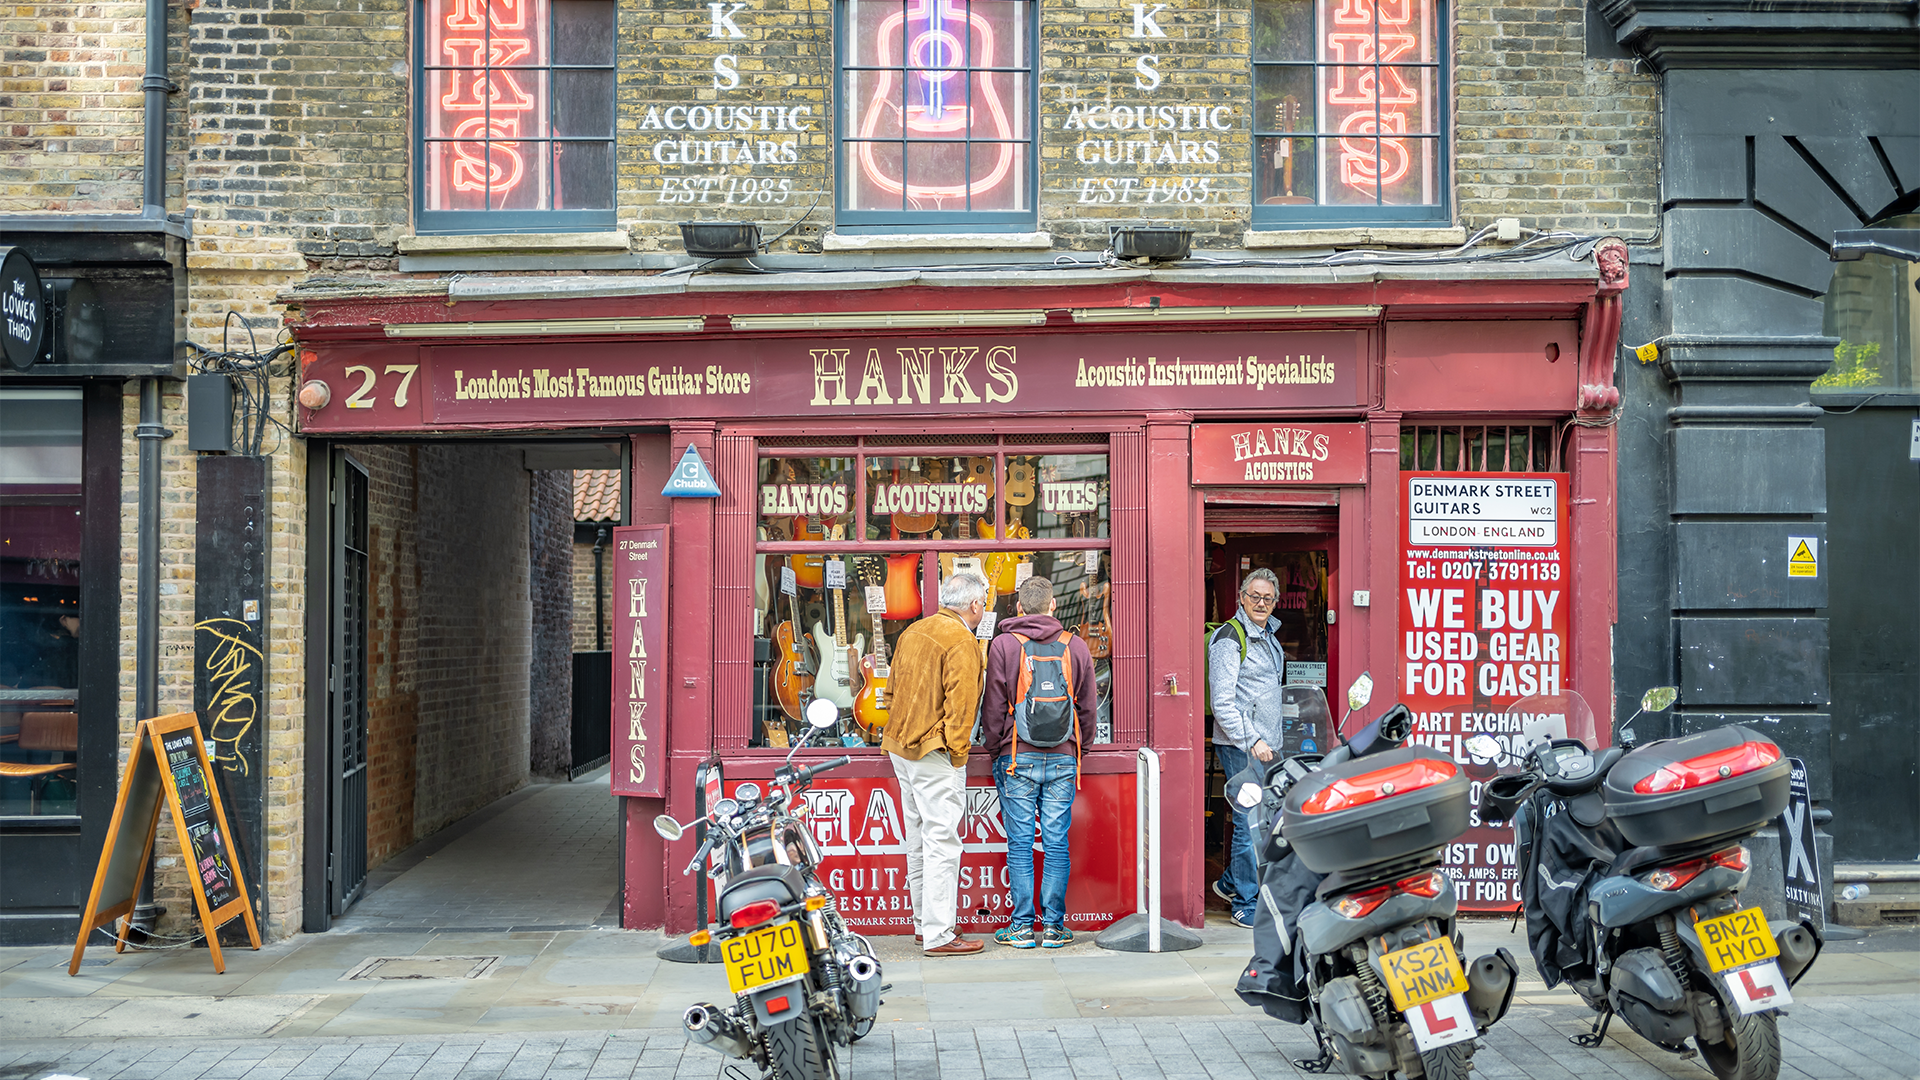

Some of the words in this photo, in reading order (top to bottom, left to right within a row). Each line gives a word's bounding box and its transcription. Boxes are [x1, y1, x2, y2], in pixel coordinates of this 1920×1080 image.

[640, 104, 812, 132] ACOUSTIC
[1063, 105, 1232, 131] ACOUSTIC
[653, 140, 798, 165] GUITARS
[1076, 140, 1220, 164] GUITARS
[657, 178, 720, 203] EST
[726, 178, 792, 203] 1985
[1077, 178, 1140, 203] EST
[1146, 178, 1211, 203] 1985
[13, 281, 25, 296] THE
[3, 292, 36, 324] LOWER
[7, 319, 32, 341] THIRD
[454, 369, 531, 400] London's
[533, 369, 575, 398] Most
[576, 368, 645, 397] Famous
[647, 366, 703, 396] Guitar
[705, 365, 751, 395] Store
[809, 345, 1018, 406] HANKS
[1075, 357, 1145, 388] Acoustic
[1148, 357, 1243, 387] Instrument
[1246, 355, 1335, 391] Specialists
[344, 364, 419, 409] 27
[1231, 427, 1330, 463] HANKS
[673, 479, 707, 488] Chubb
[1244, 461, 1314, 481] ACOUSTICS
[762, 485, 847, 514] BANJOS
[874, 484, 988, 514] ACOUSTICS
[1042, 482, 1098, 511] UKES
[1413, 484, 1490, 497] DENMARK
[1495, 485, 1552, 497] STREET
[1413, 502, 1481, 514] GUITARS
[1530, 507, 1552, 515] WC2
[619, 541, 628, 549] 27
[629, 540, 658, 549] Denmark
[1423, 526, 1476, 537] LONDON
[1483, 527, 1545, 537] ENGLAND
[628, 551, 648, 561] Street
[1407, 549, 1560, 561] www.denmarkstreetonline.co.uk
[1407, 561, 1436, 579] Tel:
[1442, 562, 1483, 580] 0207
[1489, 562, 1560, 580] 3791139
[1407, 588, 1465, 628] WE
[1482, 589, 1560, 630] BUY
[1406, 631, 1478, 661] USED
[1489, 632, 1560, 662] GEAR
[628, 579, 647, 783] HANKS
[1406, 663, 1466, 695] FOR
[1479, 663, 1560, 696] CASH
[1461, 712, 1556, 732] EXCHAN
[959, 866, 1011, 889] SHO
[1469, 868, 1498, 880] AMPS,
[983, 891, 1013, 909] 198
[1475, 882, 1507, 901] FOR
[845, 917, 886, 926] ENMARK
[970, 915, 979, 924] &
[1071, 913, 1113, 921] GUITARS
[1704, 912, 1760, 945] BN21
[728, 926, 796, 963] GU70
[1715, 936, 1766, 966] HYO
[740, 953, 793, 986] FUM
[1388, 943, 1449, 979] KS21
[1400, 967, 1456, 1002] HNM
[1738, 970, 1777, 1001] L
[1420, 1001, 1458, 1035] L
